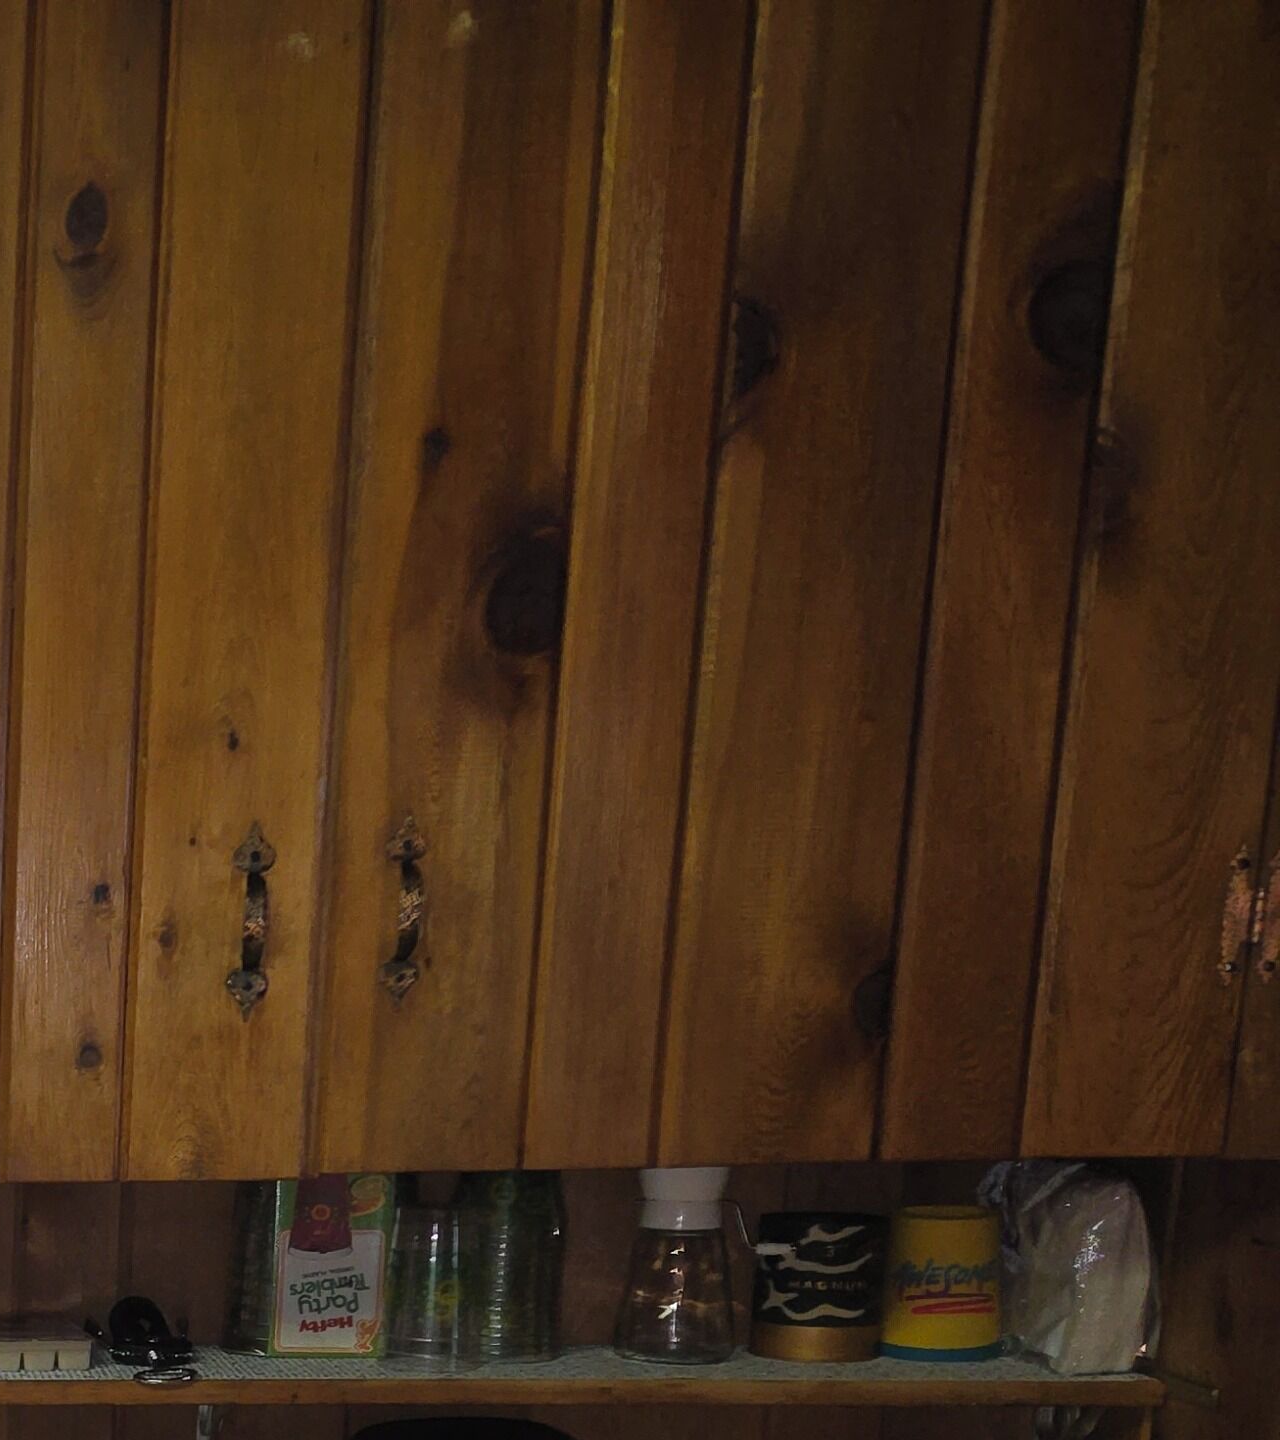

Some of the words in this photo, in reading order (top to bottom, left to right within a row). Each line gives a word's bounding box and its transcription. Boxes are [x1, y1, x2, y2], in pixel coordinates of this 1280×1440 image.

[289, 1273, 370, 1296] Tumblers
[298, 1292, 359, 1314] Party
[299, 1315, 353, 1333] Hefty
